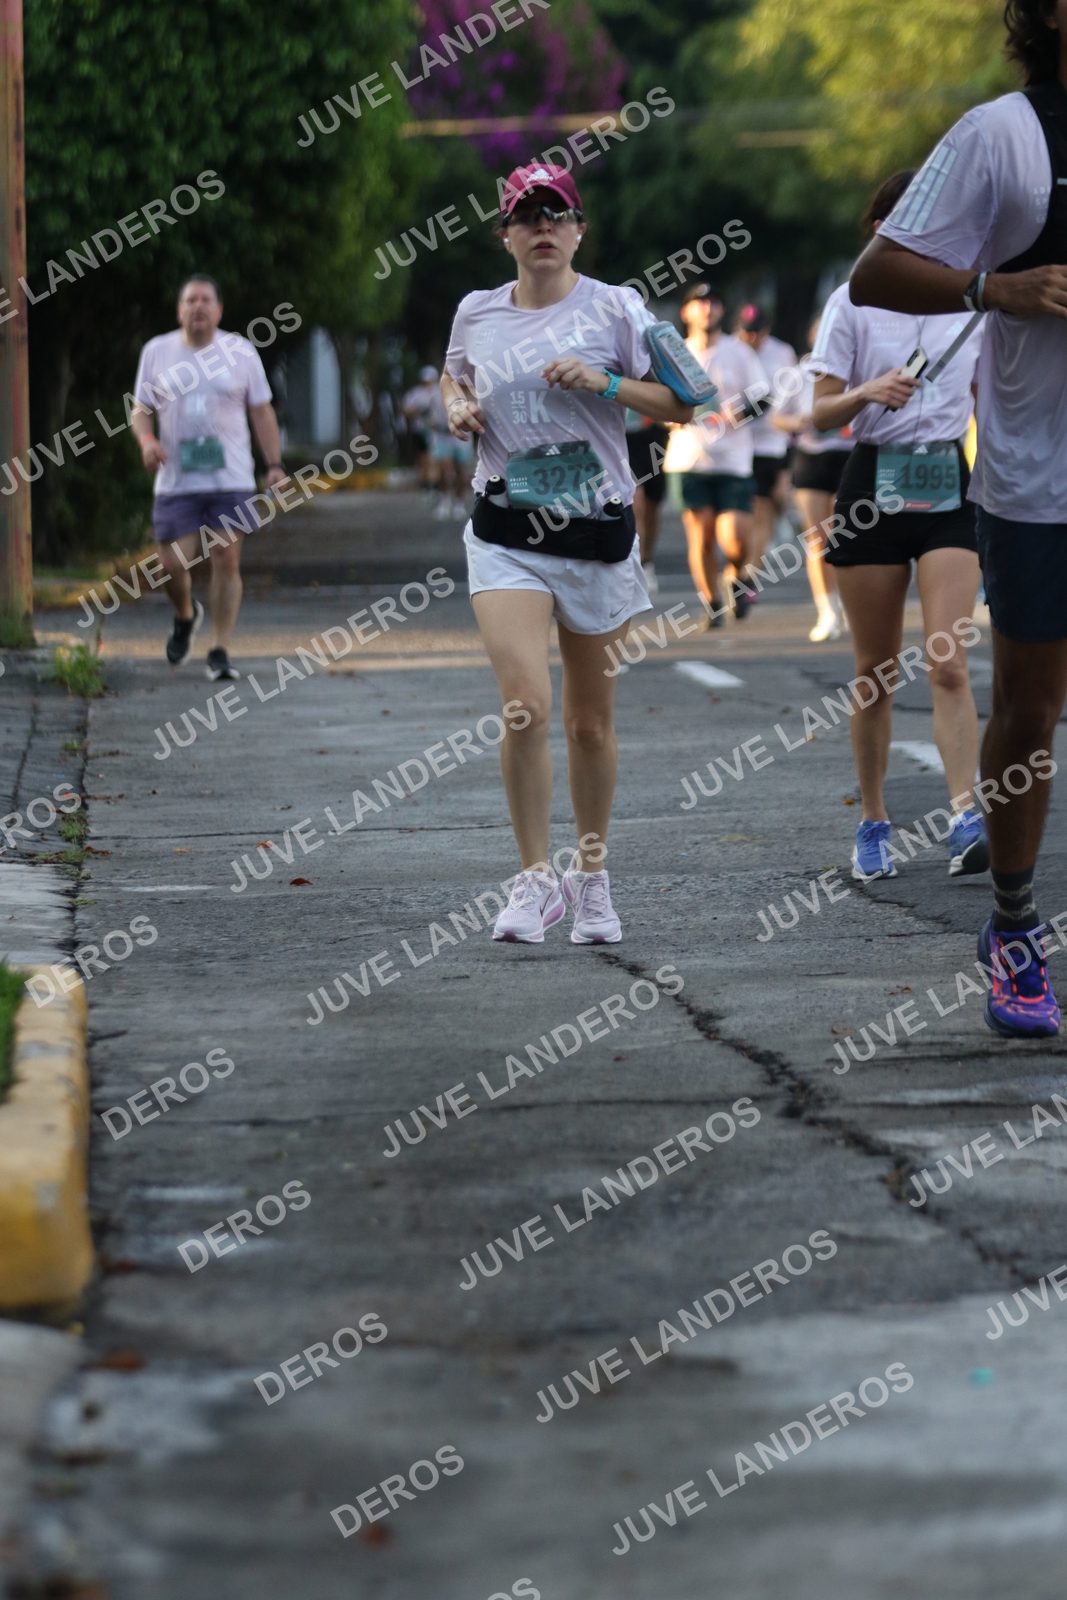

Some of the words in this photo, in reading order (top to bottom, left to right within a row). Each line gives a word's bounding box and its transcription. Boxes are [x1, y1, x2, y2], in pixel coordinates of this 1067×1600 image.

[512, 411, 527, 424] 30
[529, 391, 551, 424] K
[901, 464, 957, 490] 1995
